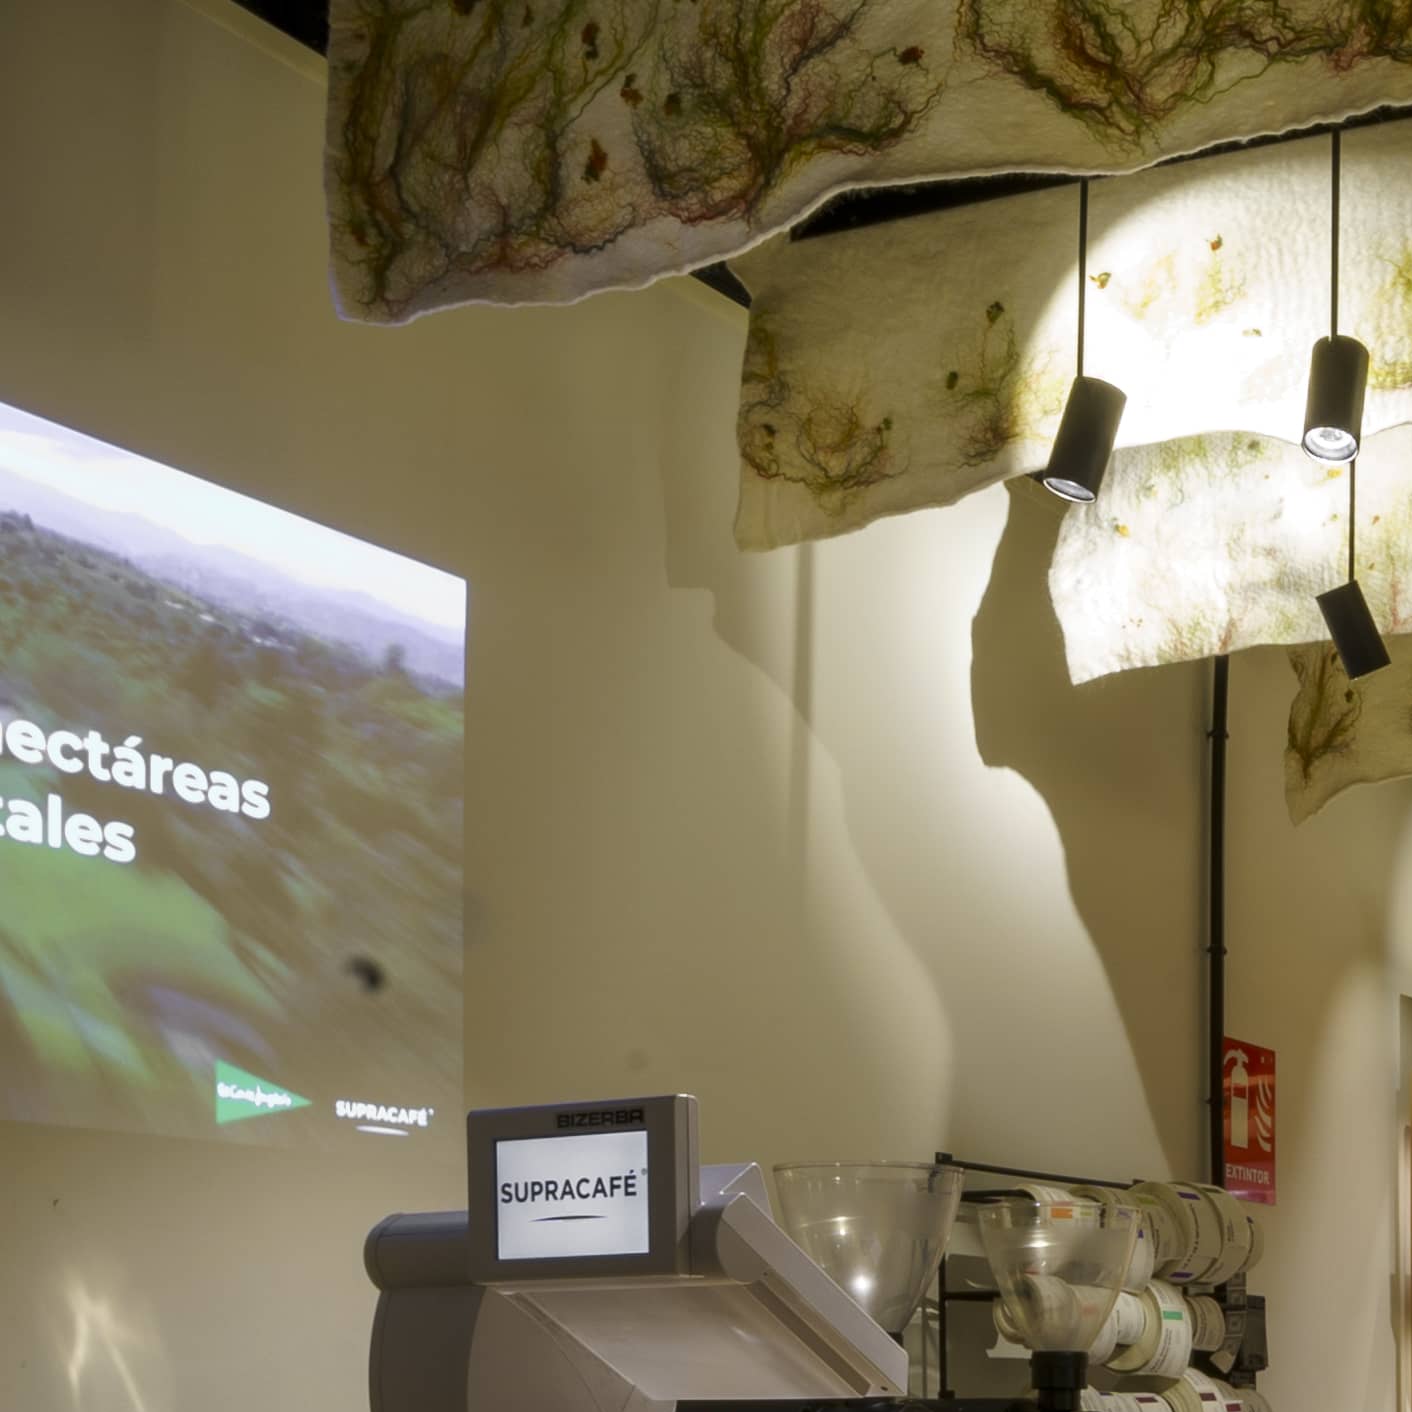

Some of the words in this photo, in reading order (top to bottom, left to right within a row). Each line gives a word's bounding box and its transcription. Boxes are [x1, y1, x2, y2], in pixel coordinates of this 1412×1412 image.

[0, 719, 271, 819] ectáreas
[557, 1109, 645, 1128] BIZERBA
[501, 1169, 637, 1204] SUPRACAFÉ
[1225, 1163, 1270, 1185] EXTINTOR
